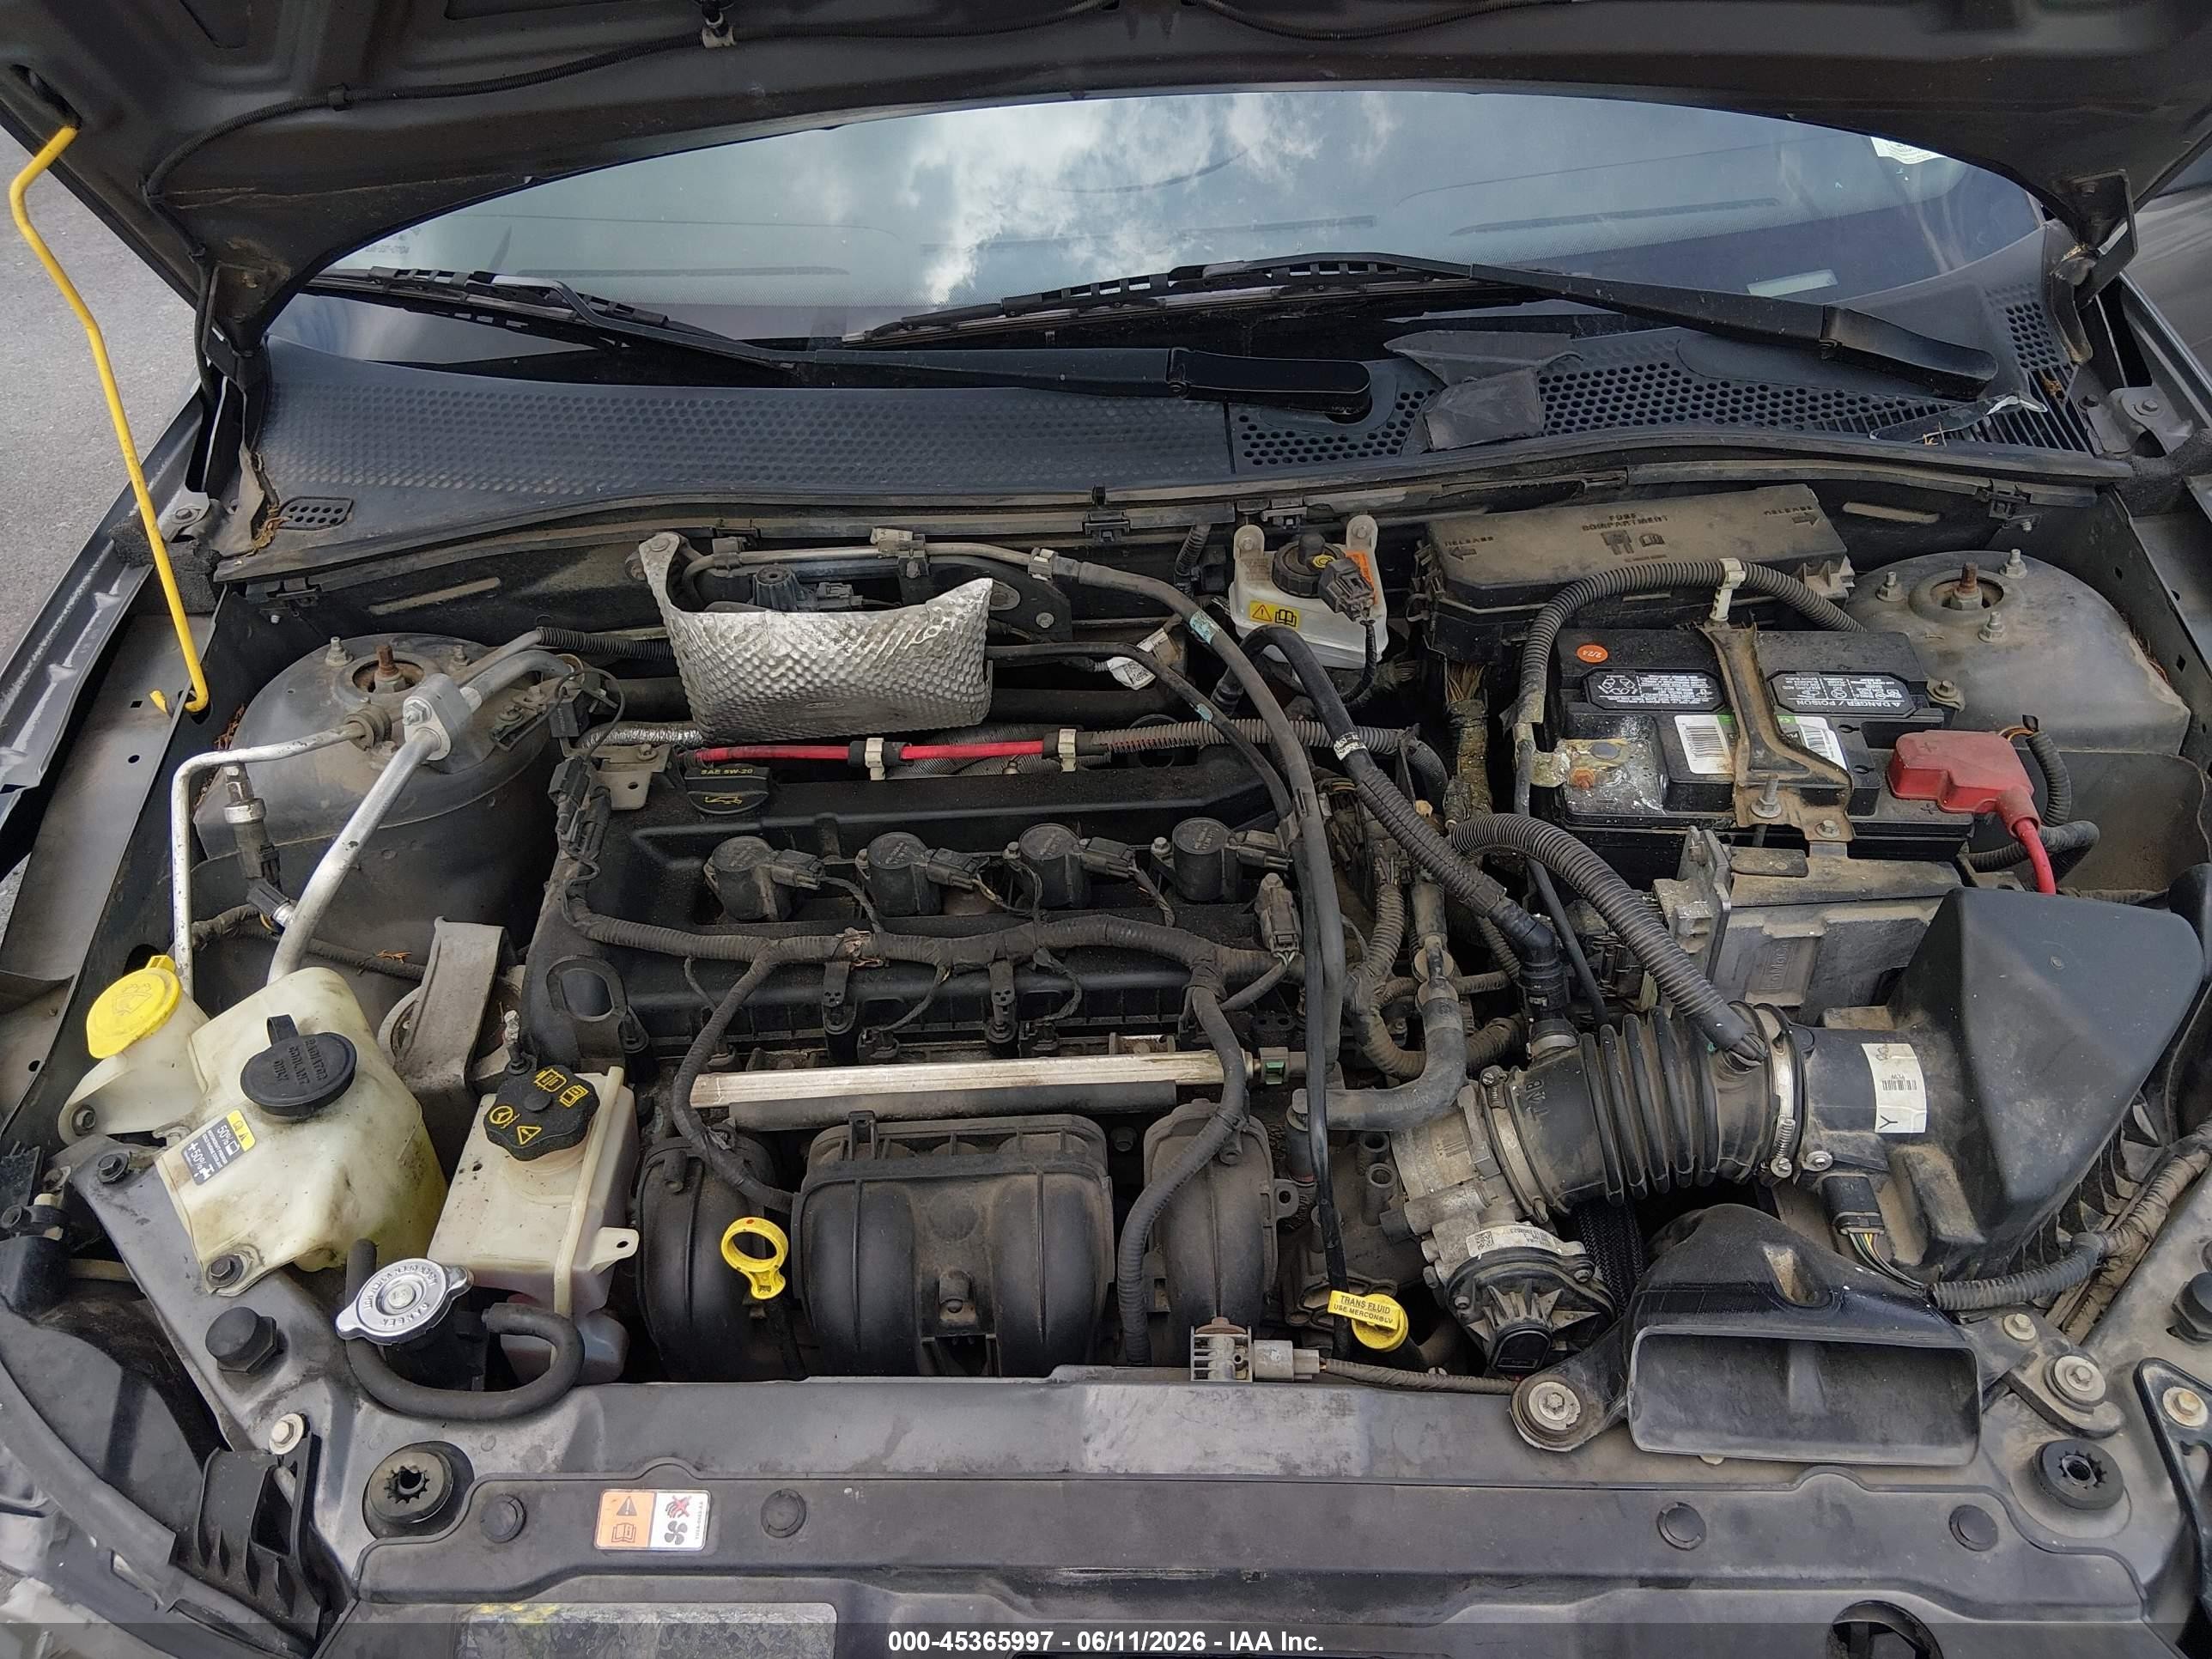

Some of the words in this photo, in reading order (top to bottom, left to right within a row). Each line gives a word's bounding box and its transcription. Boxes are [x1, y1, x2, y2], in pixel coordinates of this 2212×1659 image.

[1582, 515, 1668, 531] COMPARTMENT
[1608, 513, 1637, 521] FUSE
[289, 1045, 310, 1086] COOLANT
[304, 1038, 328, 1081] RADIATOR
[273, 1058, 289, 1084] ONLY
[216, 1125, 232, 1145] 50%
[380, 1302, 430, 1327] DANGER
[1334, 1304, 1348, 1313] USE
[1340, 1295, 1366, 1309] TRANS
[1367, 1302, 1391, 1315] FLUID
